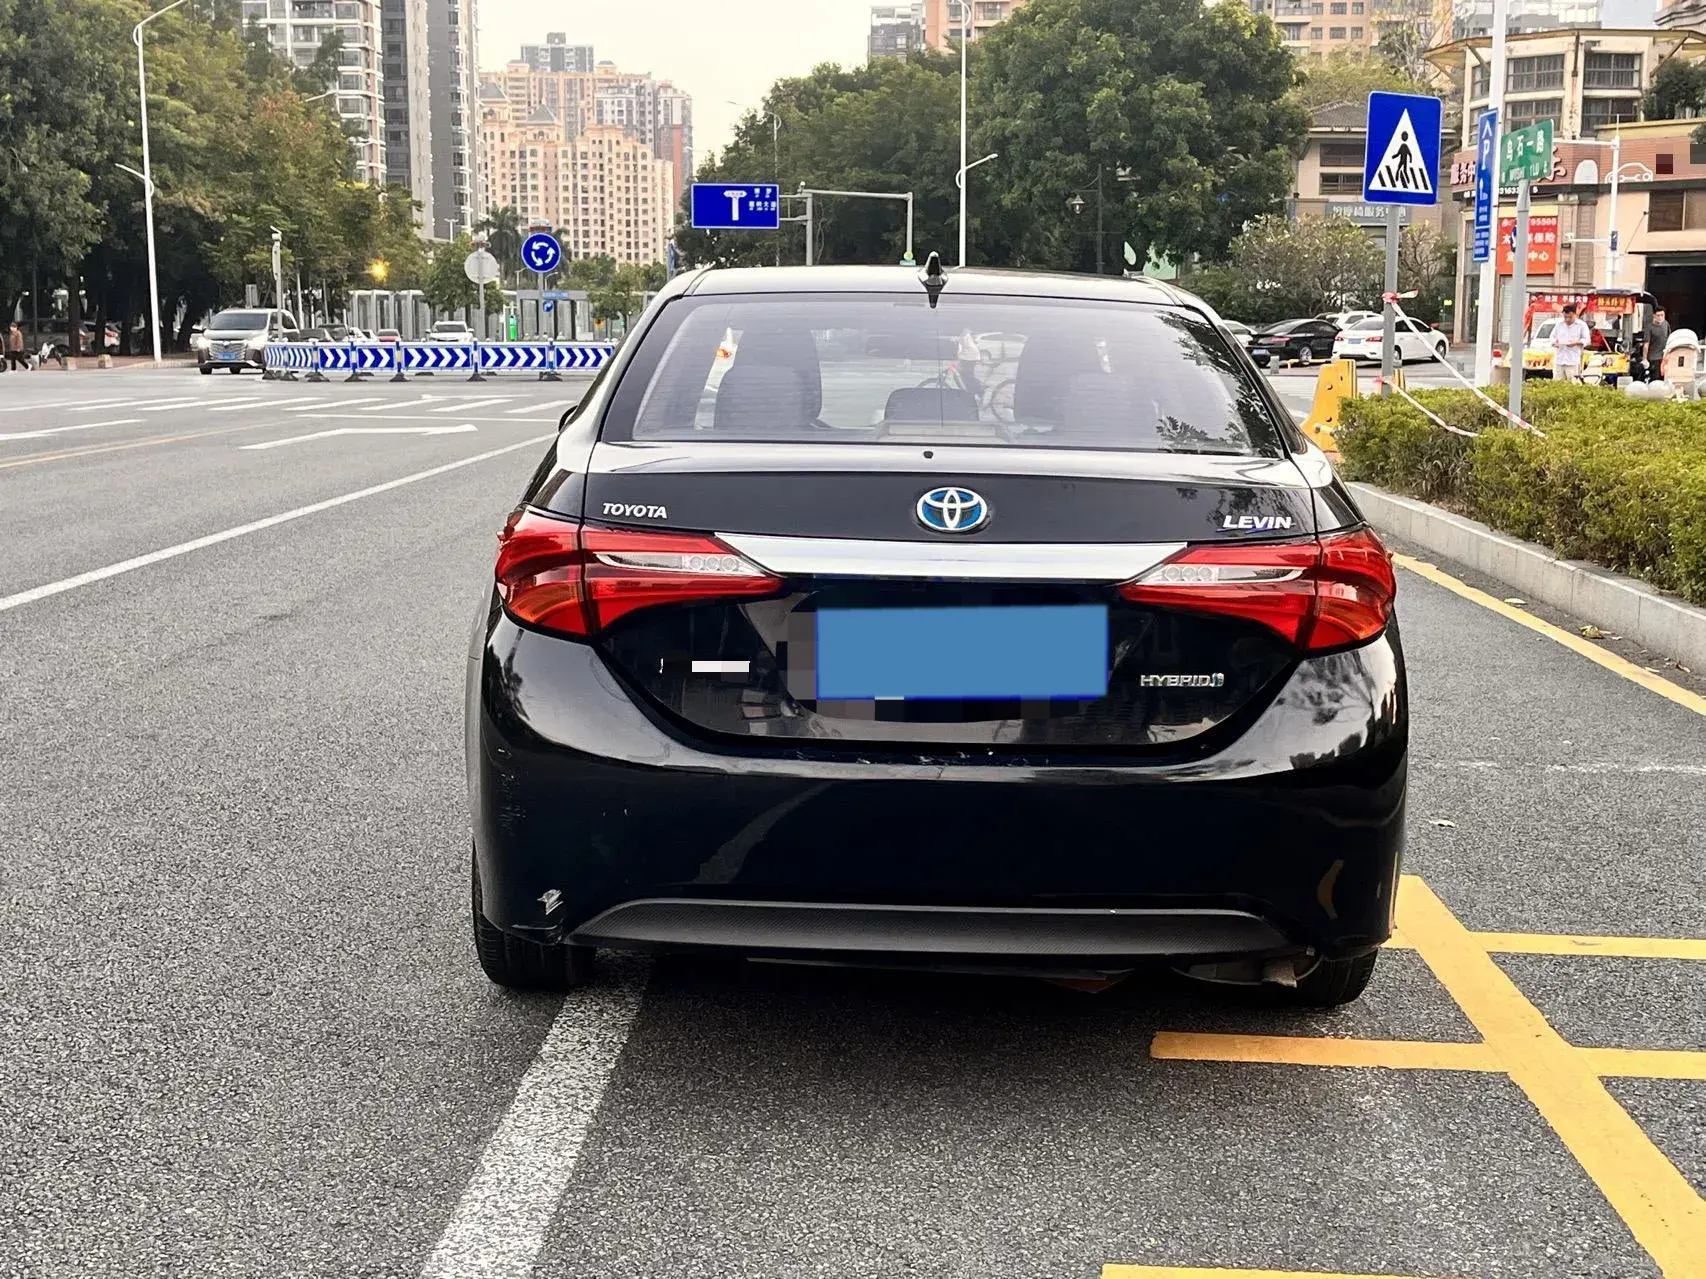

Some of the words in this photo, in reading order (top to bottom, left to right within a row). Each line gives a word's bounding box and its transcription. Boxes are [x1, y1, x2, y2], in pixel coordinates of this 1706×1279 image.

[603, 502, 668, 519] TOYOTA
[1222, 515, 1292, 529] LEVIN
[1140, 674, 1211, 687] HYBRID
